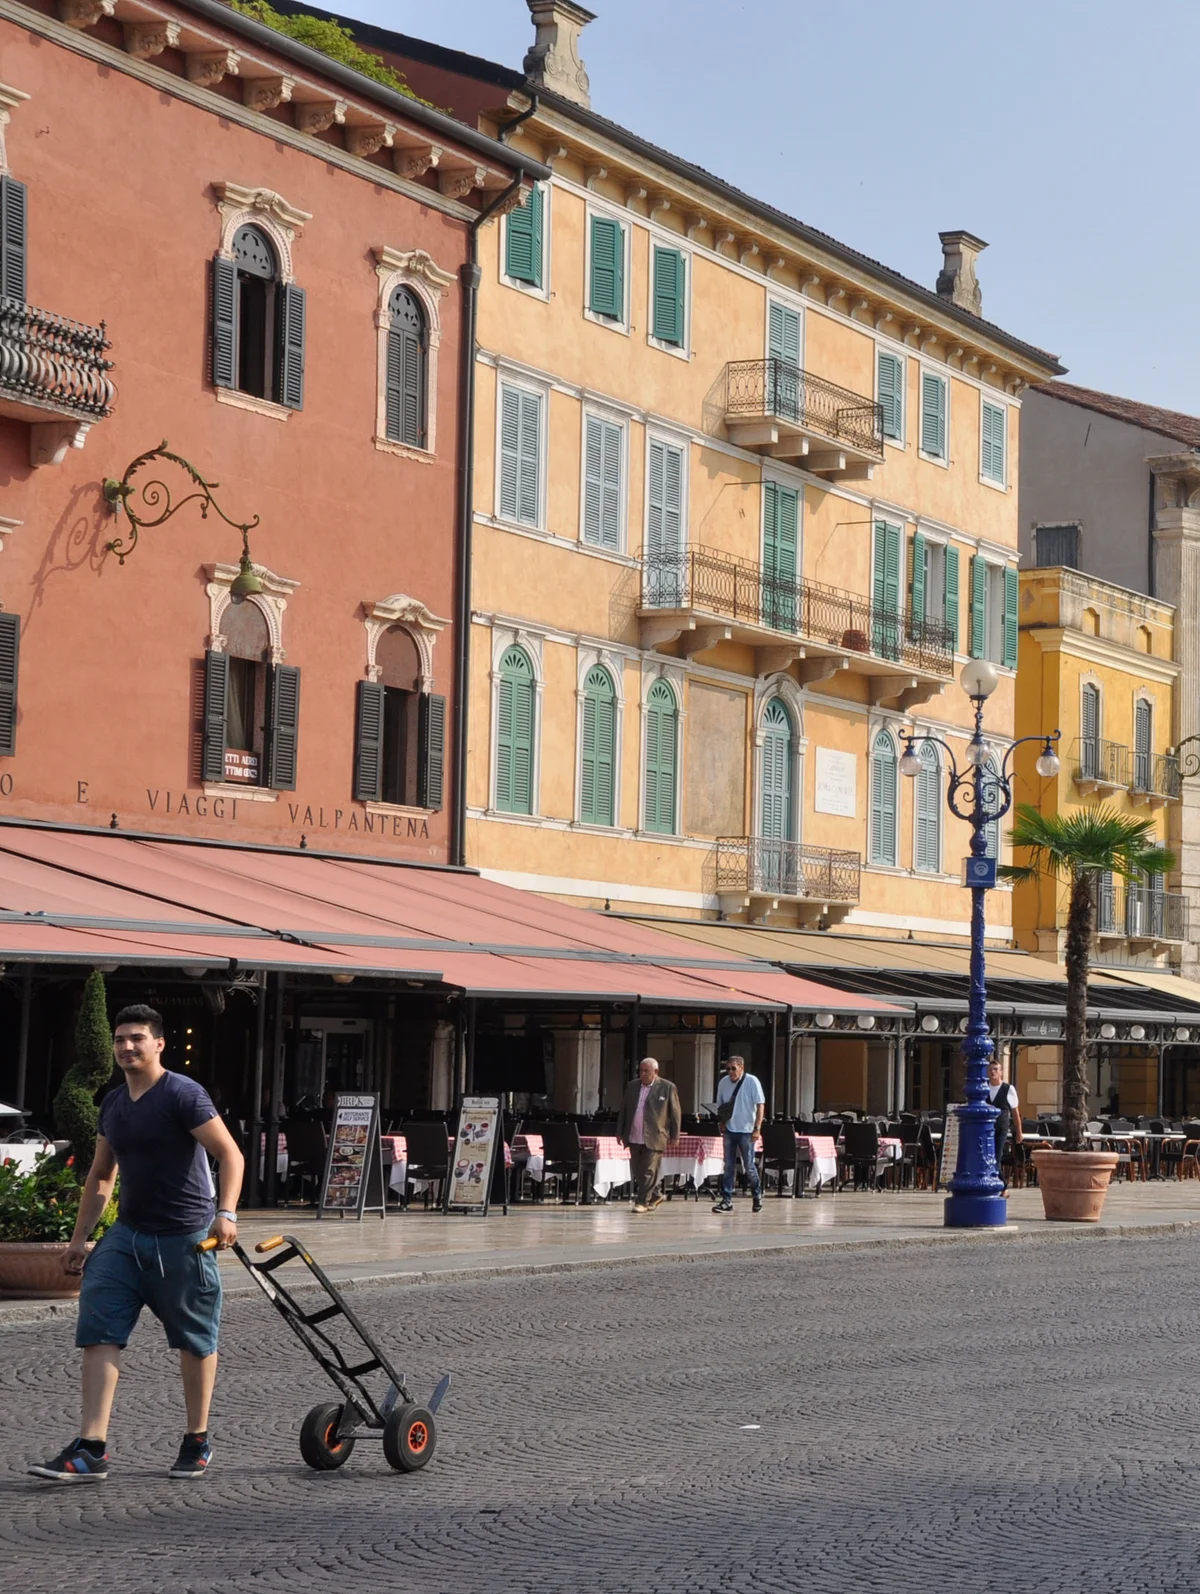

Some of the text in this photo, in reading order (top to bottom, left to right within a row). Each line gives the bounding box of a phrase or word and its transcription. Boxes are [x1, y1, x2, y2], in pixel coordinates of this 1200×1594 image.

[77, 780, 89, 803] E
[146, 788, 236, 820] VIAGGI
[288, 803, 429, 839] VALPANTENA
